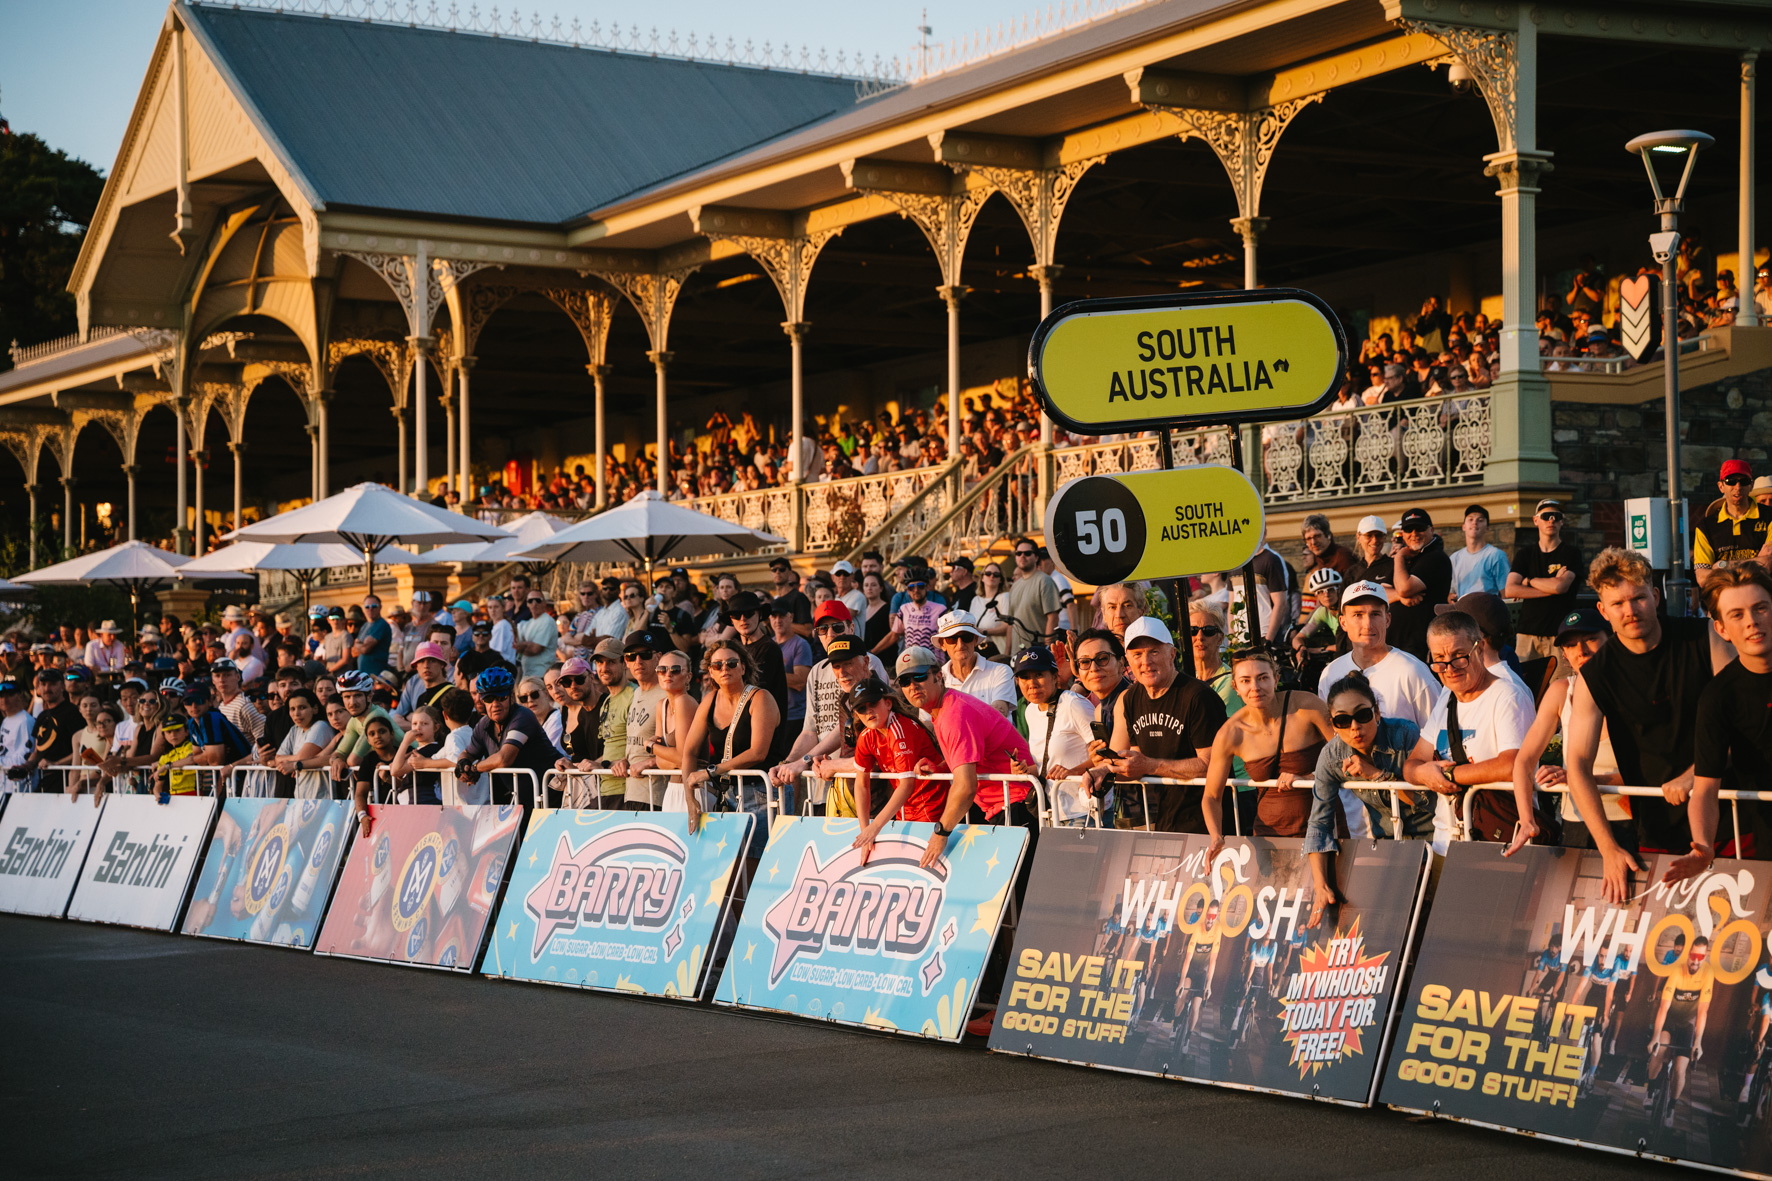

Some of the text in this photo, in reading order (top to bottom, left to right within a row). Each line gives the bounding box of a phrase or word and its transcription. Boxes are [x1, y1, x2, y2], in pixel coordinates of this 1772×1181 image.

[1137, 325, 1236, 362] SOUTH
[1108, 359, 1274, 403] AUSTRALIA
[1075, 507, 1127, 555] 50
[1160, 519, 1242, 541] AUSTRALIA
[1175, 502, 1224, 521] SOUTH
[1132, 712, 1184, 735] CYCLINGTIPS
[0, 827, 81, 879] Santini
[93, 831, 188, 889] Santini
[545, 864, 683, 928] BARRY
[785, 878, 943, 955] BARRY
[1120, 878, 1304, 941] WHOOSH
[1016, 948, 1145, 989] SAVE IT
[1327, 936, 1364, 968] TRY
[791, 964, 913, 996] LOW SUGAR LOW CARB LOW CAL
[1008, 980, 1136, 1021] FOR THE
[1286, 965, 1388, 1001] MYWHOOSH
[1001, 1010, 1128, 1044] GOOD STUFF!
[1283, 998, 1377, 1032] TODAY FOR
[1416, 984, 1598, 1040] SAVE IT
[1294, 1031, 1346, 1062] FREE!
[1405, 1022, 1588, 1080] FOR THE
[1397, 1058, 1579, 1109] GOOD STUFF!
